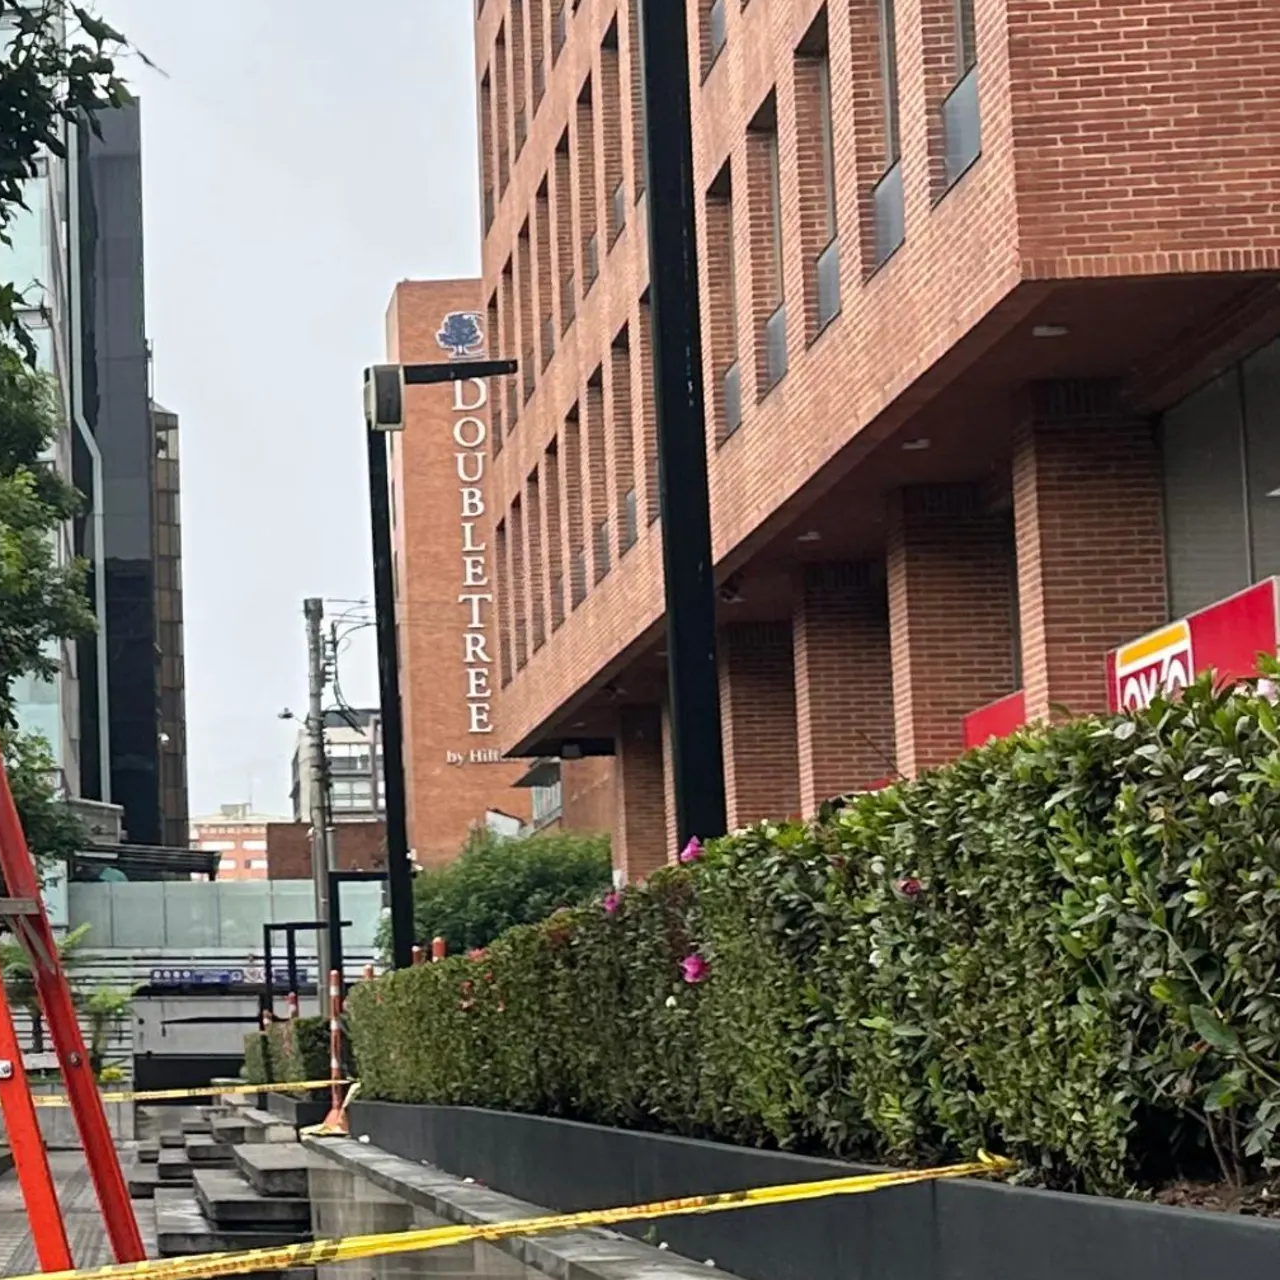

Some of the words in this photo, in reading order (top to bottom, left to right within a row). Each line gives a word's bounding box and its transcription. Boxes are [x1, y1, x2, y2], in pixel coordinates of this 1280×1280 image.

[452, 377, 493, 733] DOUBLETREE
[1124, 657, 1188, 712] OXO
[446, 749, 463, 767] by
[470, 749, 518, 762] Hilt
